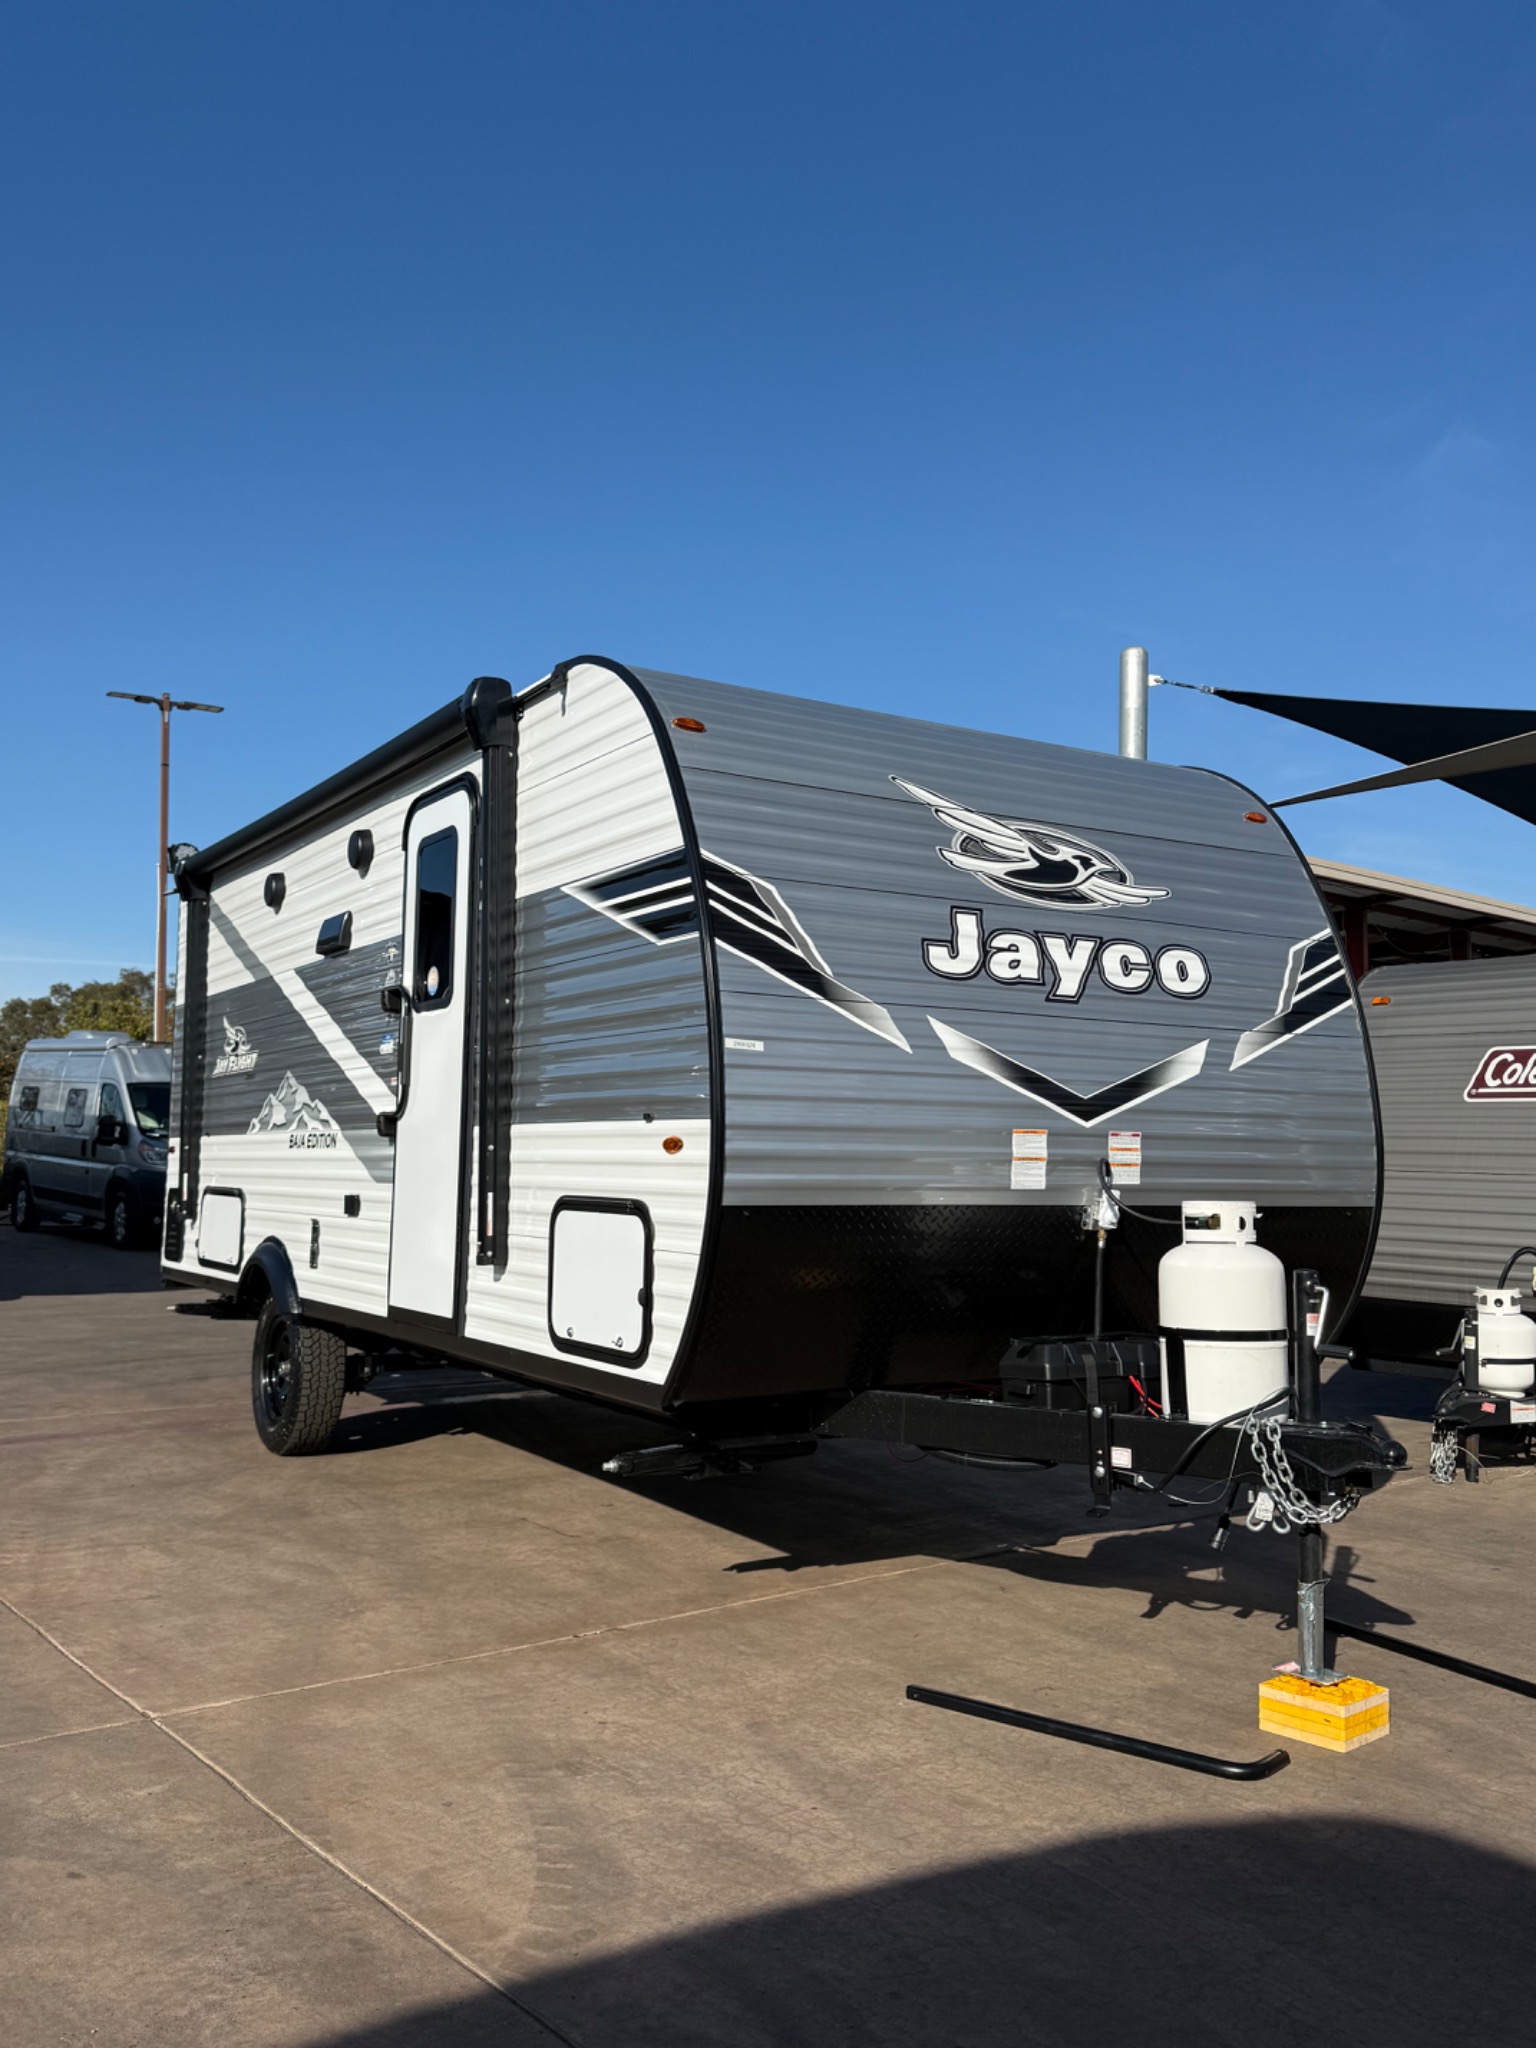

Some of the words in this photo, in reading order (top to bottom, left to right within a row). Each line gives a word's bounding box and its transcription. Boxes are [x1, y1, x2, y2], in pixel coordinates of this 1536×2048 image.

[922, 906, 1211, 1003] Jayco
[289, 1134, 305, 1149] BAJA
[307, 1133, 338, 1149] EDITION
